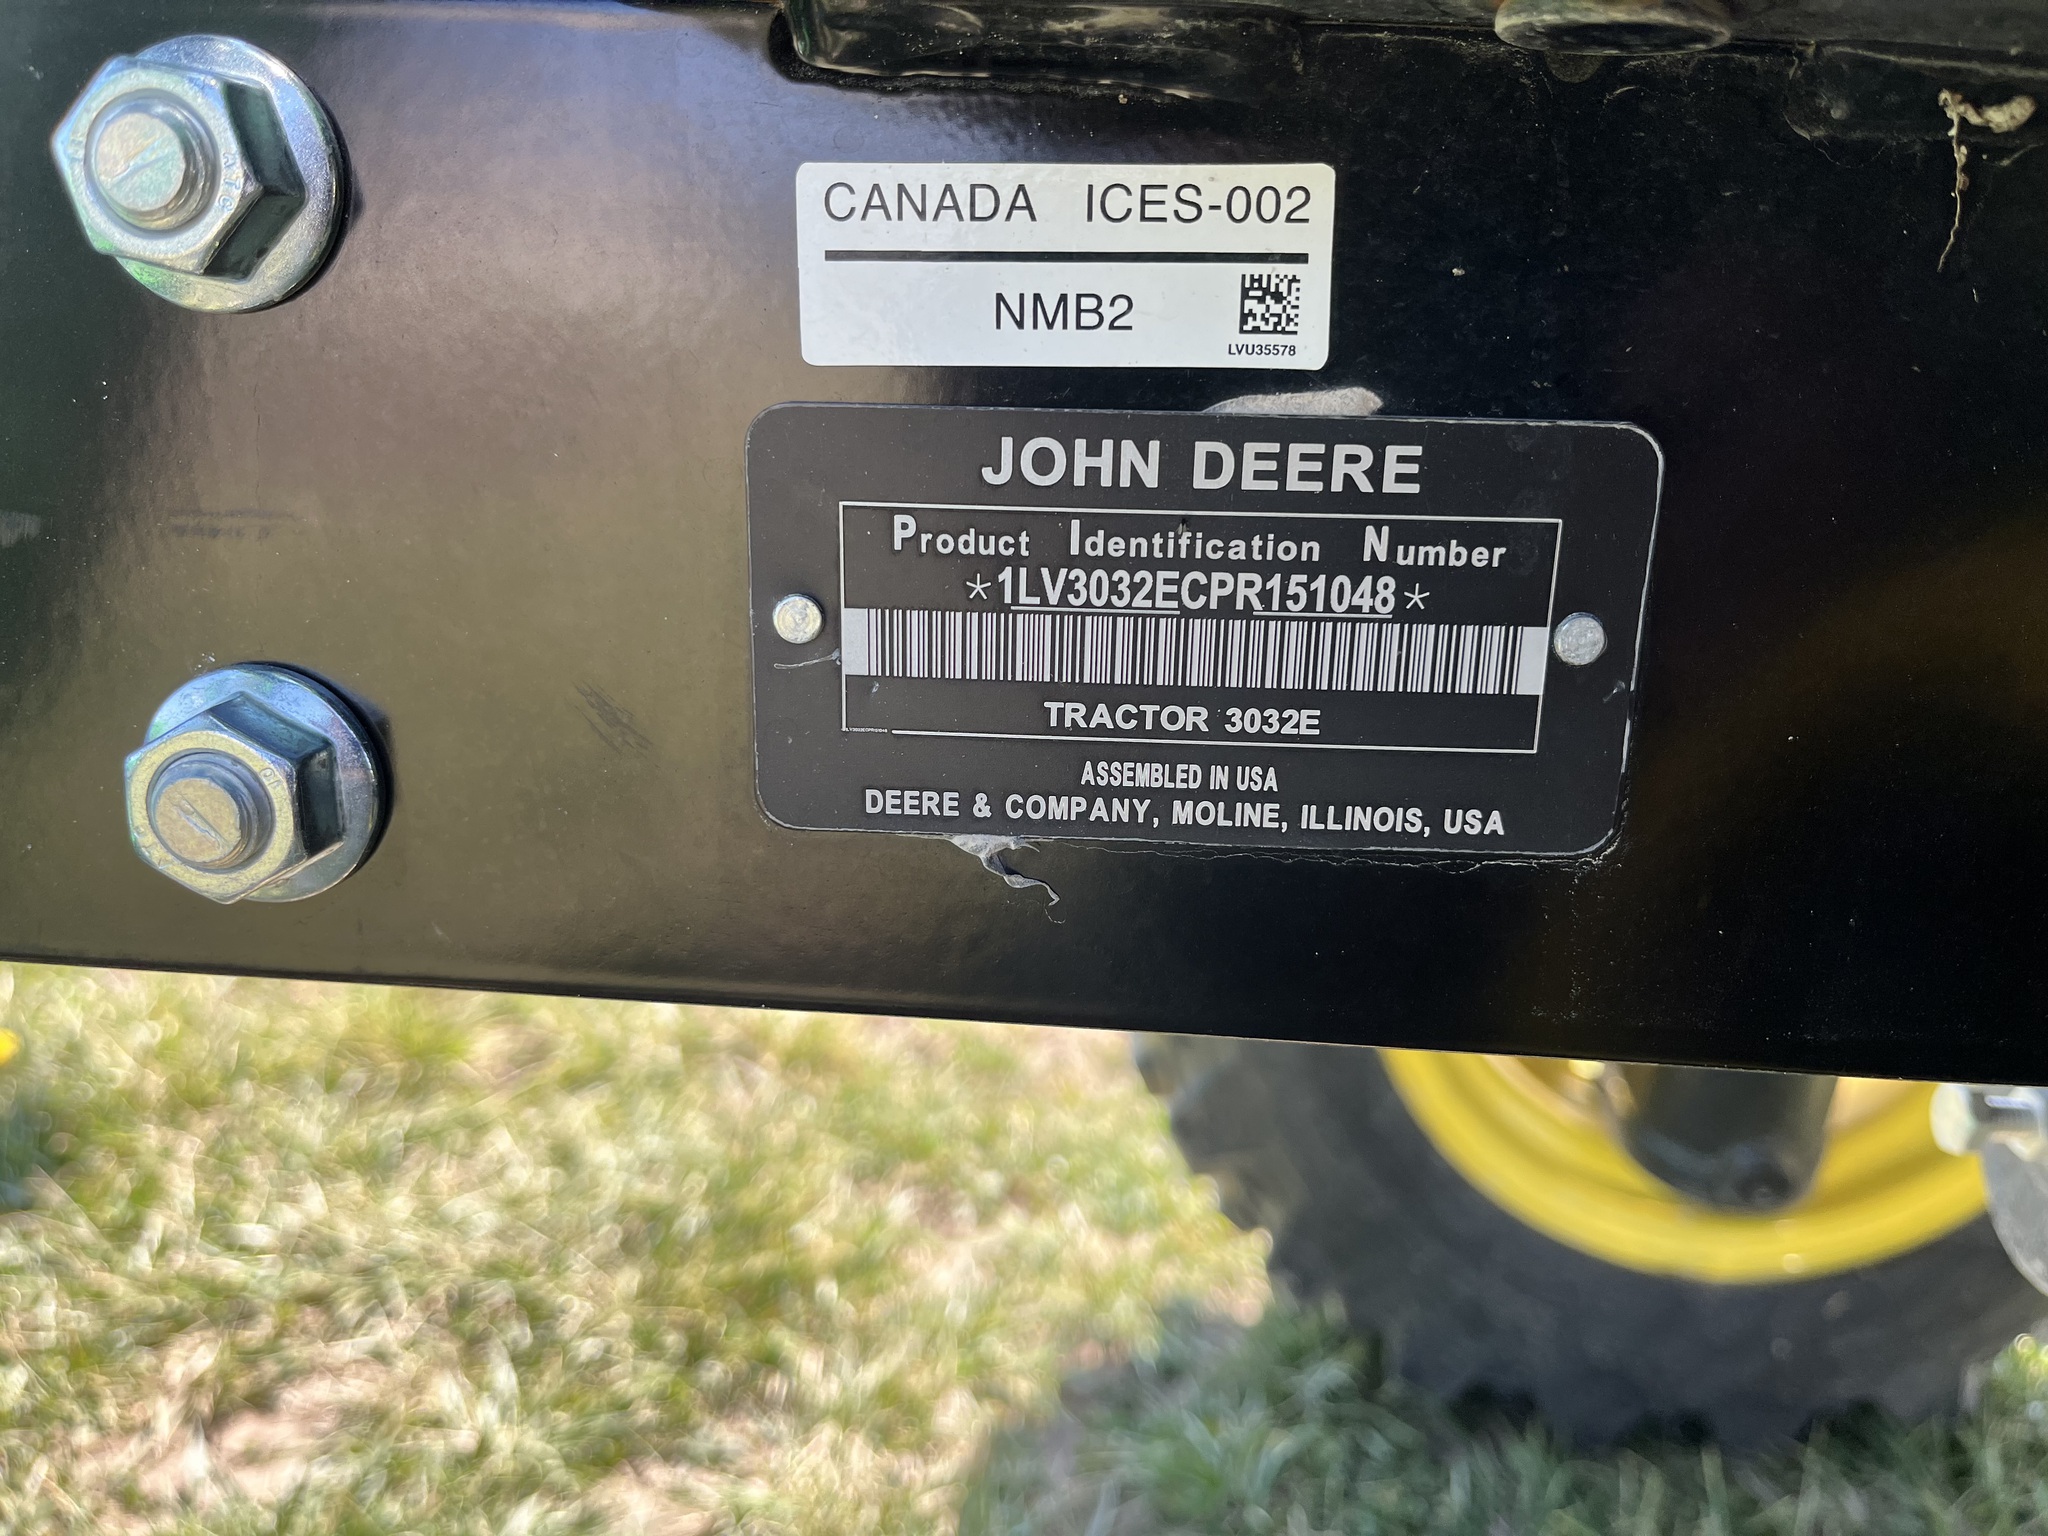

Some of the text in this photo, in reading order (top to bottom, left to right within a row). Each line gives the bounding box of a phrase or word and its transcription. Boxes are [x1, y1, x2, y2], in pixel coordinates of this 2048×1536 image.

[824, 182, 1311, 224] CANADA ICES-002
[995, 292, 1134, 331] NMB2
[1228, 343, 1296, 357] LVU35578
[981, 436, 1423, 494] JOHN DEERE
[893, 514, 1507, 568] Product Identification Number
[1044, 701, 1321, 735] TRACTOR 3032E
[1080, 760, 1279, 792] ASSEMBLED IN USA
[865, 788, 1505, 837] DEERE & COMPANY, MOLINE, ILLINOIS, USA
